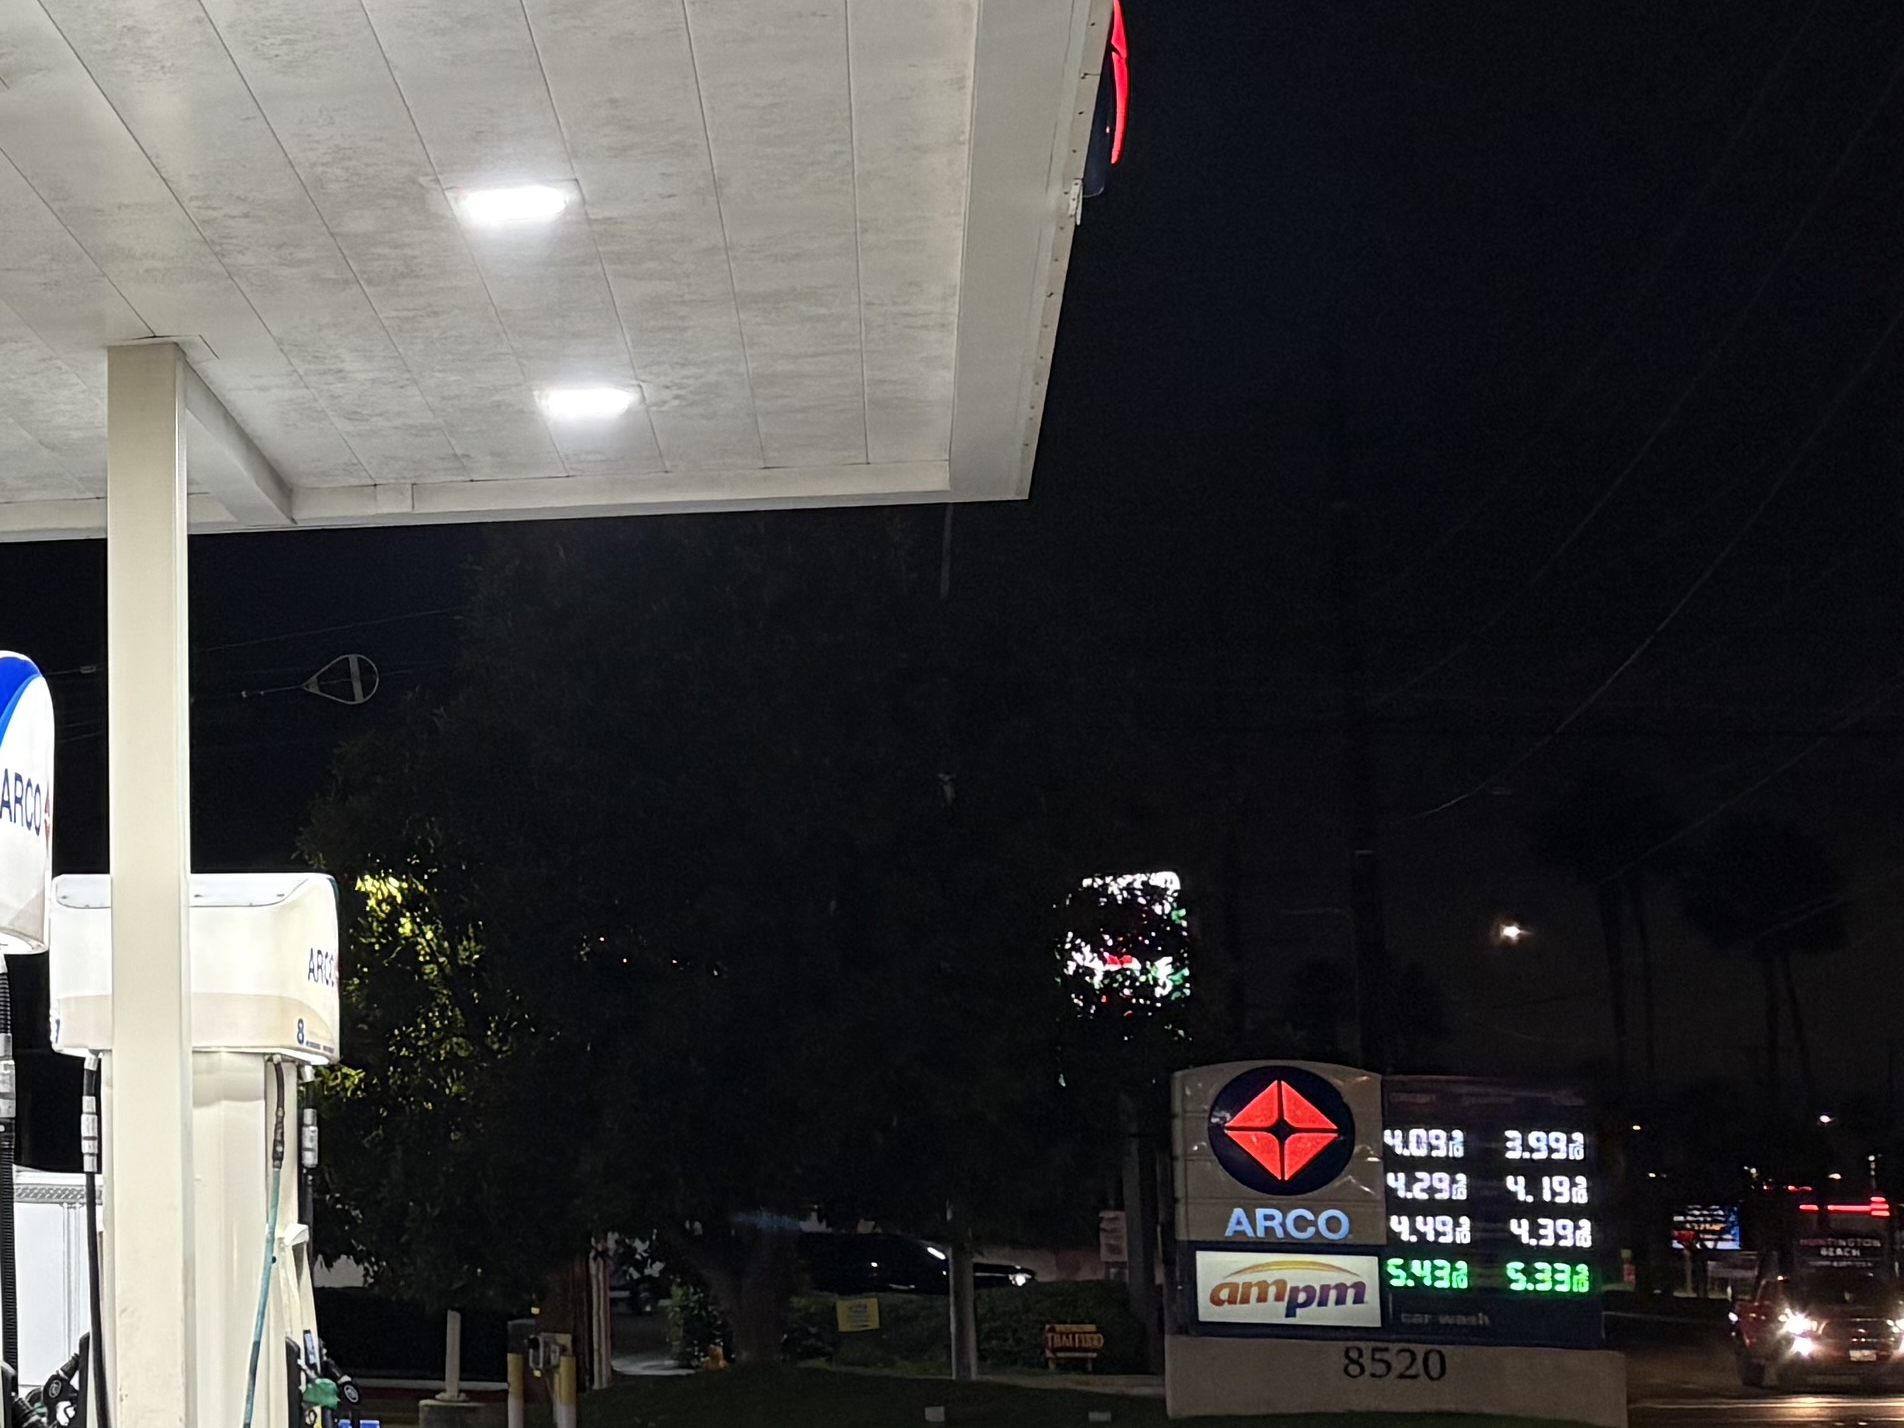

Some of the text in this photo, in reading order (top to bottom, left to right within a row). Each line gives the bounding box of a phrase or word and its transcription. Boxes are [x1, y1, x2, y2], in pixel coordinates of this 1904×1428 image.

[0, 768, 42, 837] ARCO
[308, 947, 334, 988] ARCO
[297, 1018, 304, 1044] 8
[1224, 1207, 1350, 1240] ARCO
[1209, 1278, 1366, 1319] ampm
[1344, 1345, 1446, 1381] 8520
